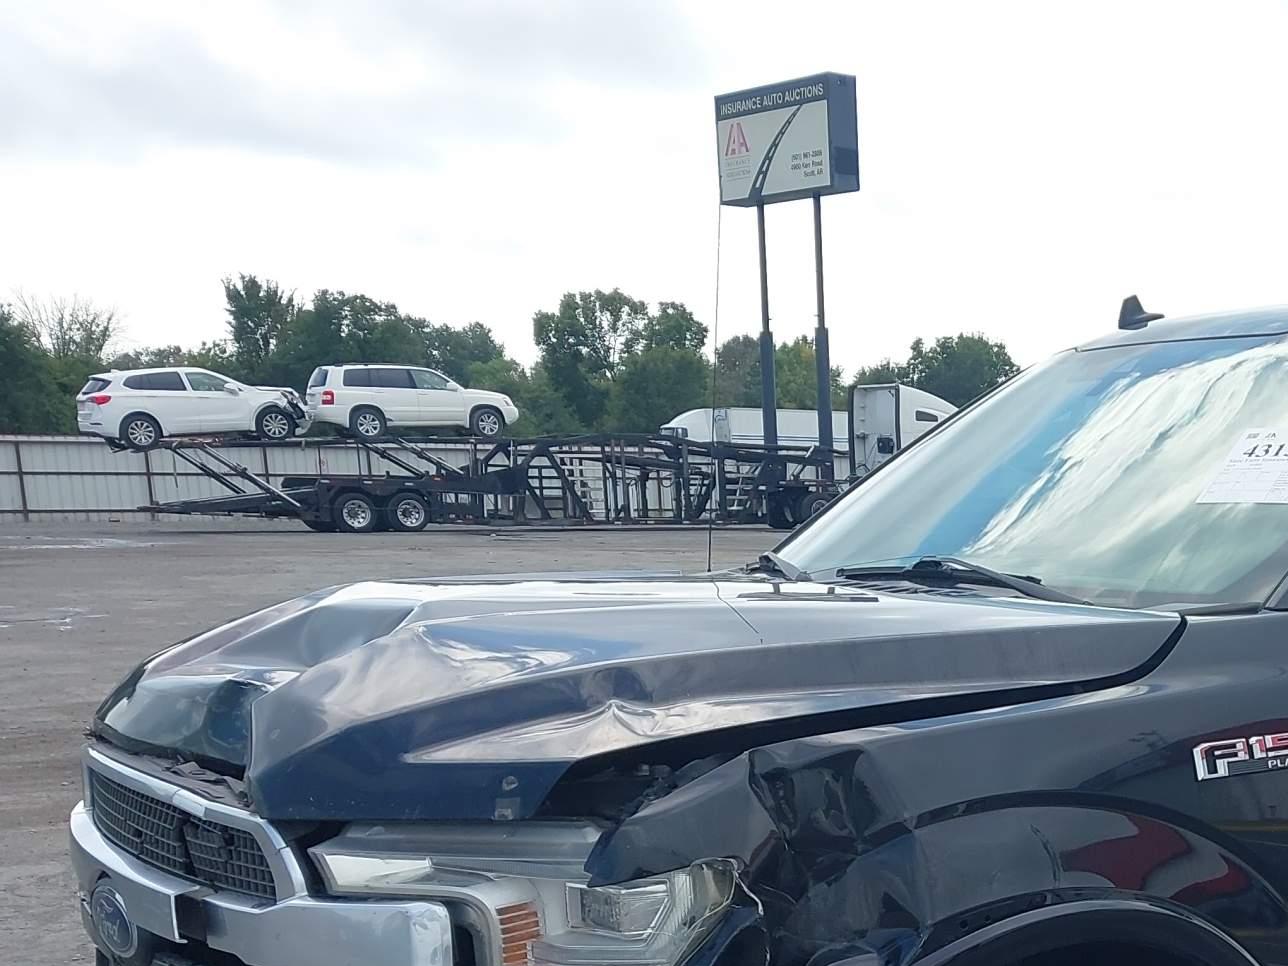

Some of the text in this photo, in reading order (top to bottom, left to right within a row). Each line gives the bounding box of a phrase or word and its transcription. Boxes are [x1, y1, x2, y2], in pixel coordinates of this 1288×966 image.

[720, 83, 824, 116] INSURANCE AUTO AUCTIONS
